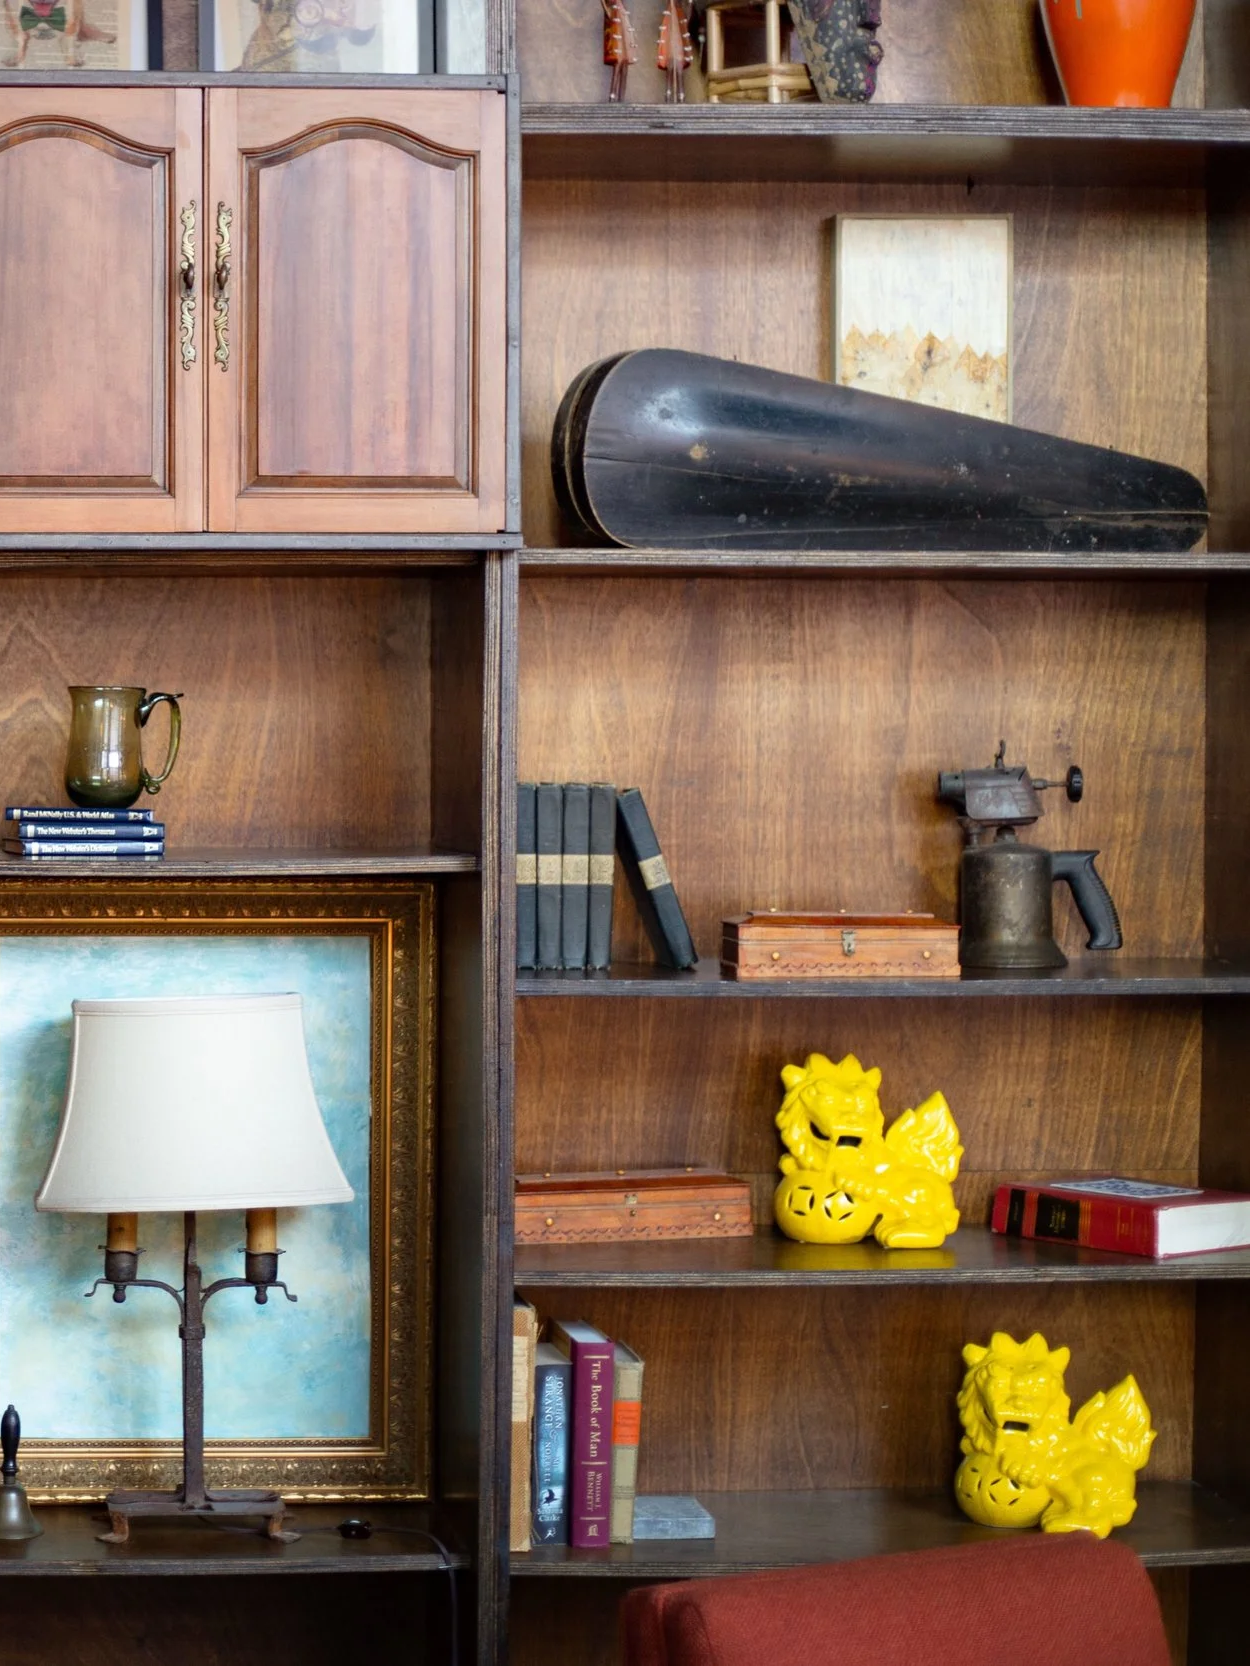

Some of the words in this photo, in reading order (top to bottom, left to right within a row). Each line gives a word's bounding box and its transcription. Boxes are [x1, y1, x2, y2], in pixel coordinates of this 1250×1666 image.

[592, 1361, 601, 1380] The
[545, 1375, 553, 1428] STRANGE
[555, 1375, 564, 1429] JONATHAN
[591, 1385, 602, 1414] Book
[590, 1417, 600, 1428] of
[590, 1432, 601, 1457] Man
